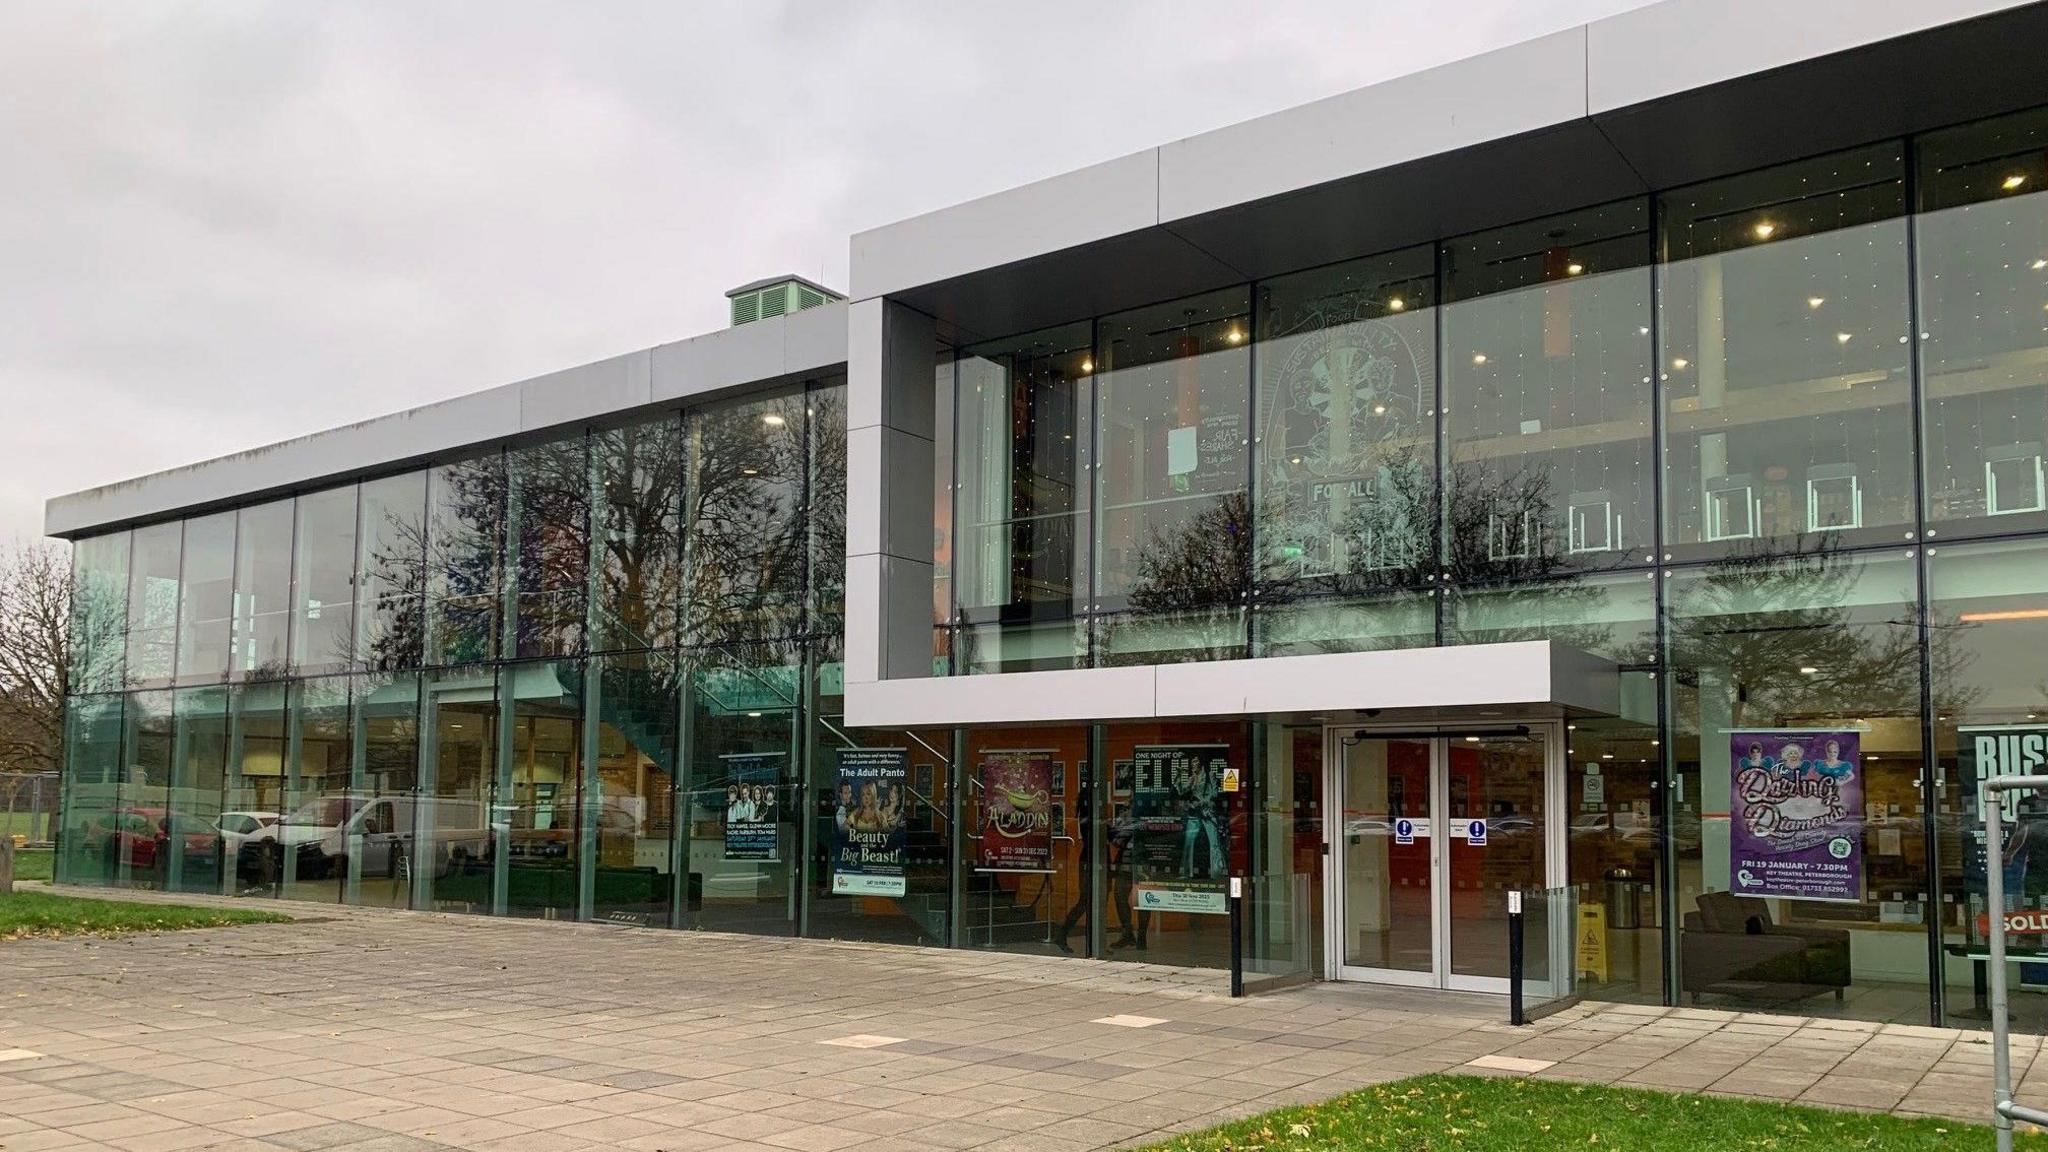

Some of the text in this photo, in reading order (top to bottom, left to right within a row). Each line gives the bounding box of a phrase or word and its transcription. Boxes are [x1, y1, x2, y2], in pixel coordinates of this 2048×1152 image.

[1975, 734, 2048, 780] RUS
[839, 768, 905, 777] The Adult Panto
[1135, 758, 1228, 793] ELVS
[1771, 762, 1791, 777] The
[1743, 803, 1849, 839] Diamonds
[848, 828, 890, 848] Beauty
[841, 847, 899, 867] Big Beast!
[1742, 860, 1755, 868] FRI
[1756, 860, 1767, 868] 19
[1768, 861, 1809, 870] JANUARY
[1816, 863, 1848, 872] 7.30PM
